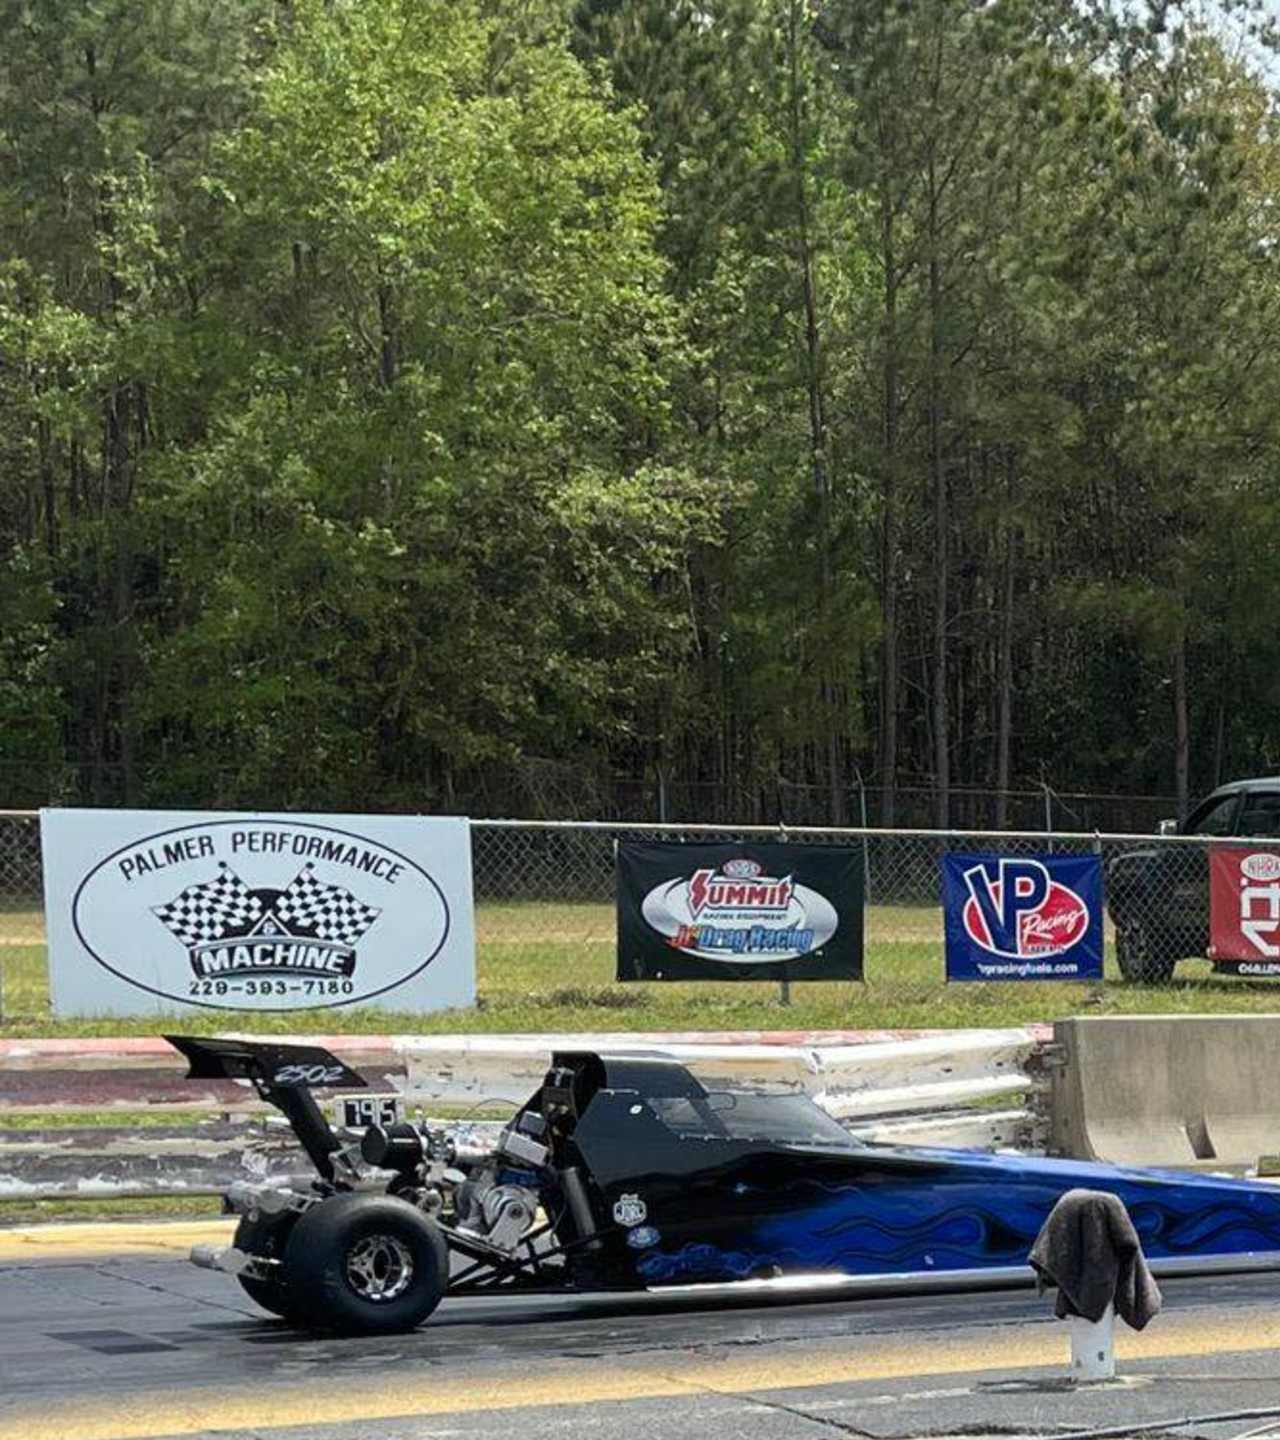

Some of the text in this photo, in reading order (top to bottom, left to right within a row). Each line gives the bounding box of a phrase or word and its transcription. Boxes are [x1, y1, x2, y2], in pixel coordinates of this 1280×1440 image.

[118, 831, 407, 885] PALMER PERFORMANCE
[1247, 861, 1280, 873] NHRA
[963, 858, 1051, 956] VP
[699, 925, 748, 953] Drag
[749, 924, 815, 953] Racing
[1022, 909, 1087, 945] Racing
[201, 943, 348, 975] MACHINE
[189, 980, 354, 996] 229-393-7180
